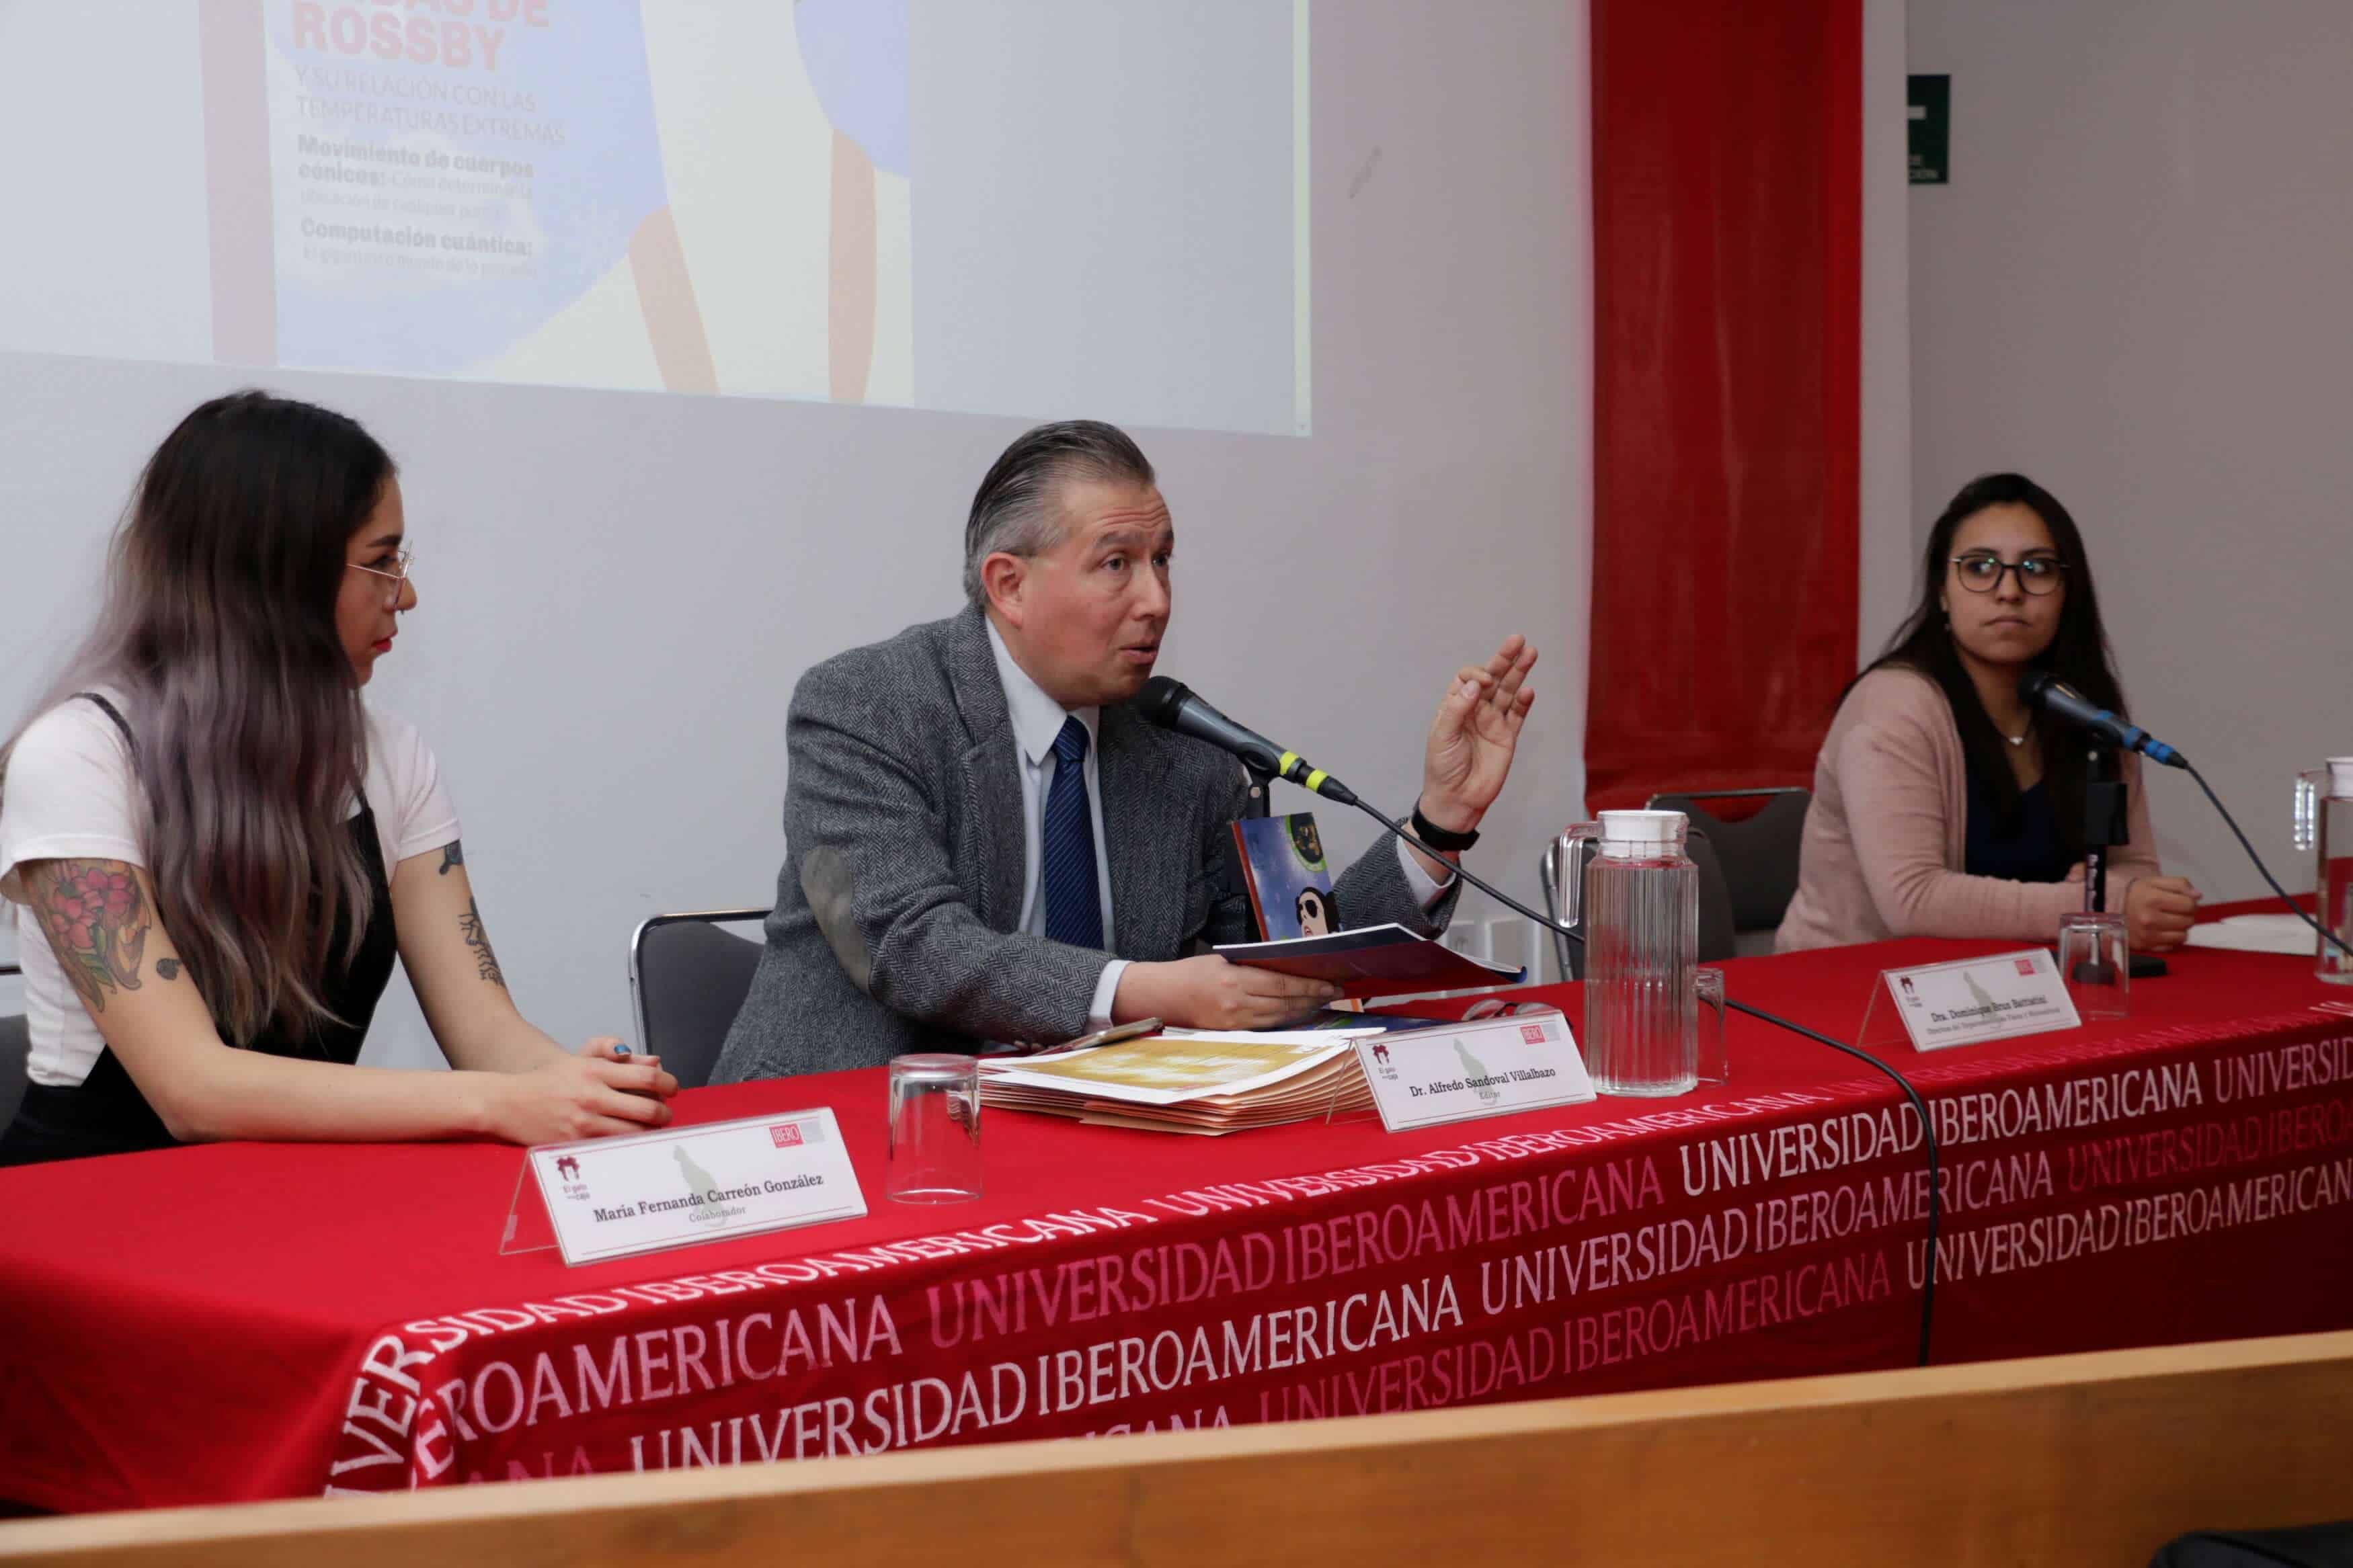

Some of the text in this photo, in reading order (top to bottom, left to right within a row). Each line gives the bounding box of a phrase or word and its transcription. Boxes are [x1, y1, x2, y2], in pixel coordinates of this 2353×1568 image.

[294, 1, 506, 71] ROSSBY
[296, 65, 309, 85] Y
[344, 70, 448, 102] RELACIÓN
[452, 85, 498, 108] CON
[500, 89, 537, 114] LAS
[296, 95, 566, 145] TEMPERATURAS EXTREMAS
[297, 134, 535, 180] Movimiento de cuerpos
[297, 161, 385, 188] cónicos:
[301, 216, 533, 257] Computación cuántica:
[1409, 1067, 1556, 1098] Dr. Alfredo Sandoval Villalbazo
[593, 1173, 824, 1223] María Fernanda Carreón González
[611, 1206, 1158, 1305] IBEROAMERICANA
[1142, 1145, 1480, 1216] UNIVERSIDAD
[1458, 1091, 1834, 1161] IBEROAMERICANA
[411, 1294, 903, 1491] EROAMERICANA
[926, 1232, 1275, 1348] UNIVERSIDAD
[1283, 1155, 1665, 1284] IBEROAMERICANA
[1679, 1102, 1924, 1196] UNIVERSIDAD
[1928, 1061, 2203, 1147] IBEROAMERICANA
[630, 1362, 1027, 1473] UNIVERSIDAD
[1038, 1275, 1464, 1415] IBEROAMERICANA
[1481, 1208, 1748, 1315] UNIVERSIDAD
[1755, 1151, 2055, 1253] IBEROAMERICANA
[2067, 1116, 2262, 1192] UNIVERSIDAD
[1564, 1250, 1892, 1374] IBEROAMERICANA
[1907, 1204, 2120, 1290] UNIVERSIDAD
